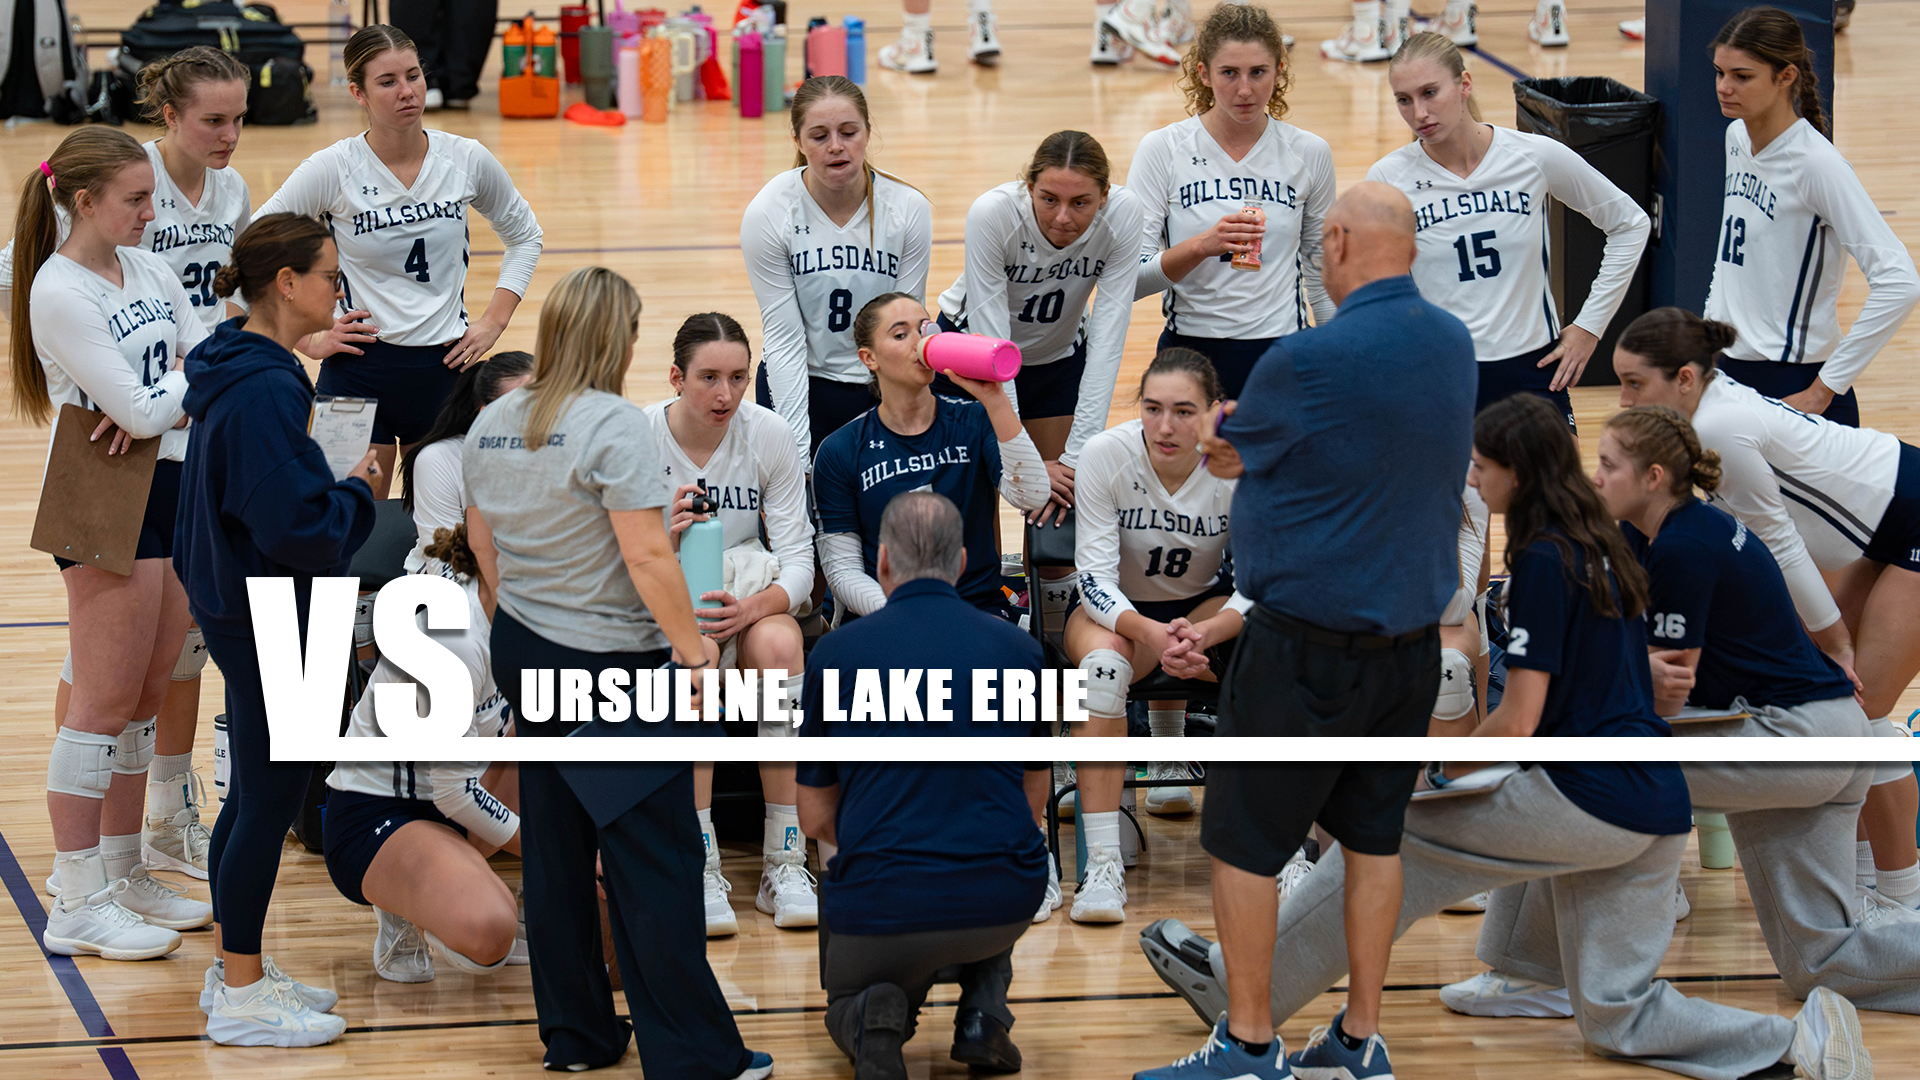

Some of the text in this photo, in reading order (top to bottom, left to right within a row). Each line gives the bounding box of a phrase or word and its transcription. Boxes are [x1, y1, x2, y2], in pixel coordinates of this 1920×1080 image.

[1179, 177, 1297, 210] HILLSDALE
[353, 200, 463, 236] HILLSDALE
[1721, 214, 1746, 267] 12
[404, 237, 430, 283] 4
[1453, 230, 1502, 282] 15
[183, 261, 221, 307] 20
[1018, 288, 1065, 323] 10
[828, 288, 853, 333] 8
[142, 339, 168, 387] 13
[478, 436, 508, 449] SWEAT
[860, 446, 971, 491] HILLSDALE
[1145, 546, 1192, 578] 18
[1653, 612, 1686, 639] 16
